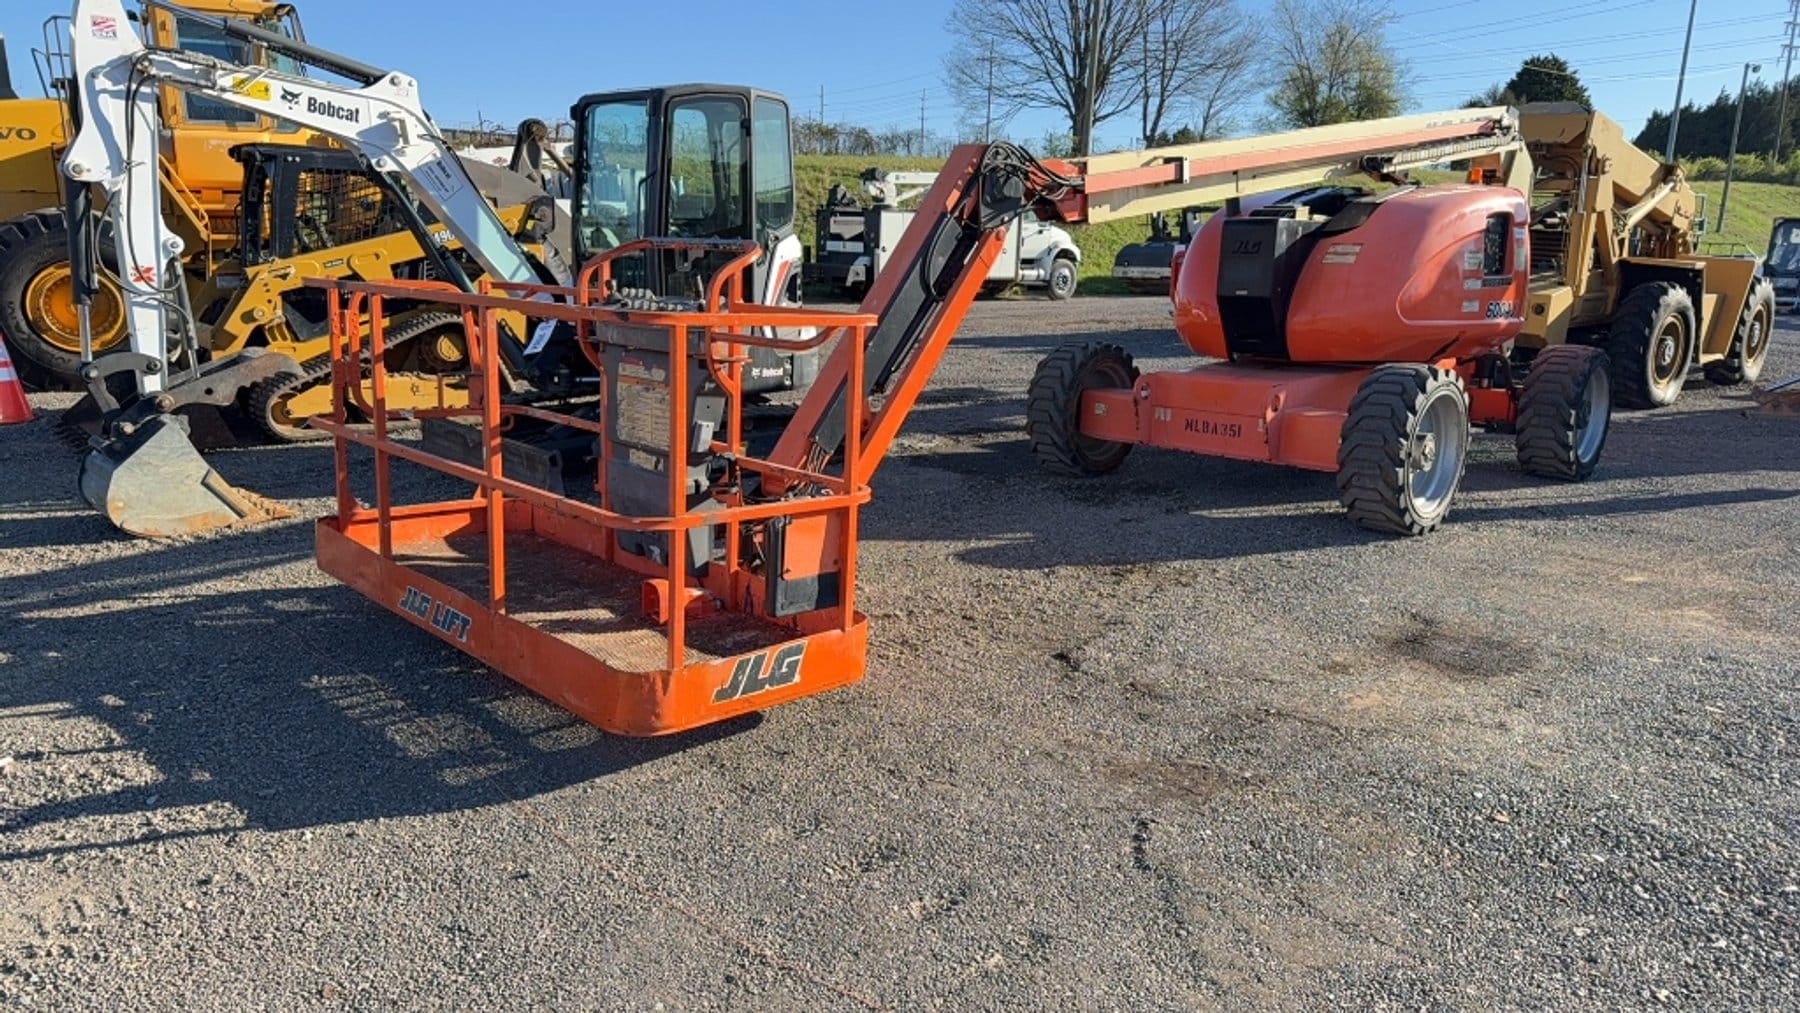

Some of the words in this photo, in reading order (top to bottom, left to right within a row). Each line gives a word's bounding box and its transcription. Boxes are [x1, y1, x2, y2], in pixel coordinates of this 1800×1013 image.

[307, 96, 359, 123] Bobcat
[1231, 240, 1263, 254] JLG
[398, 585, 432, 620] JLG
[430, 601, 472, 642] LIFT
[711, 640, 808, 705] JLG
